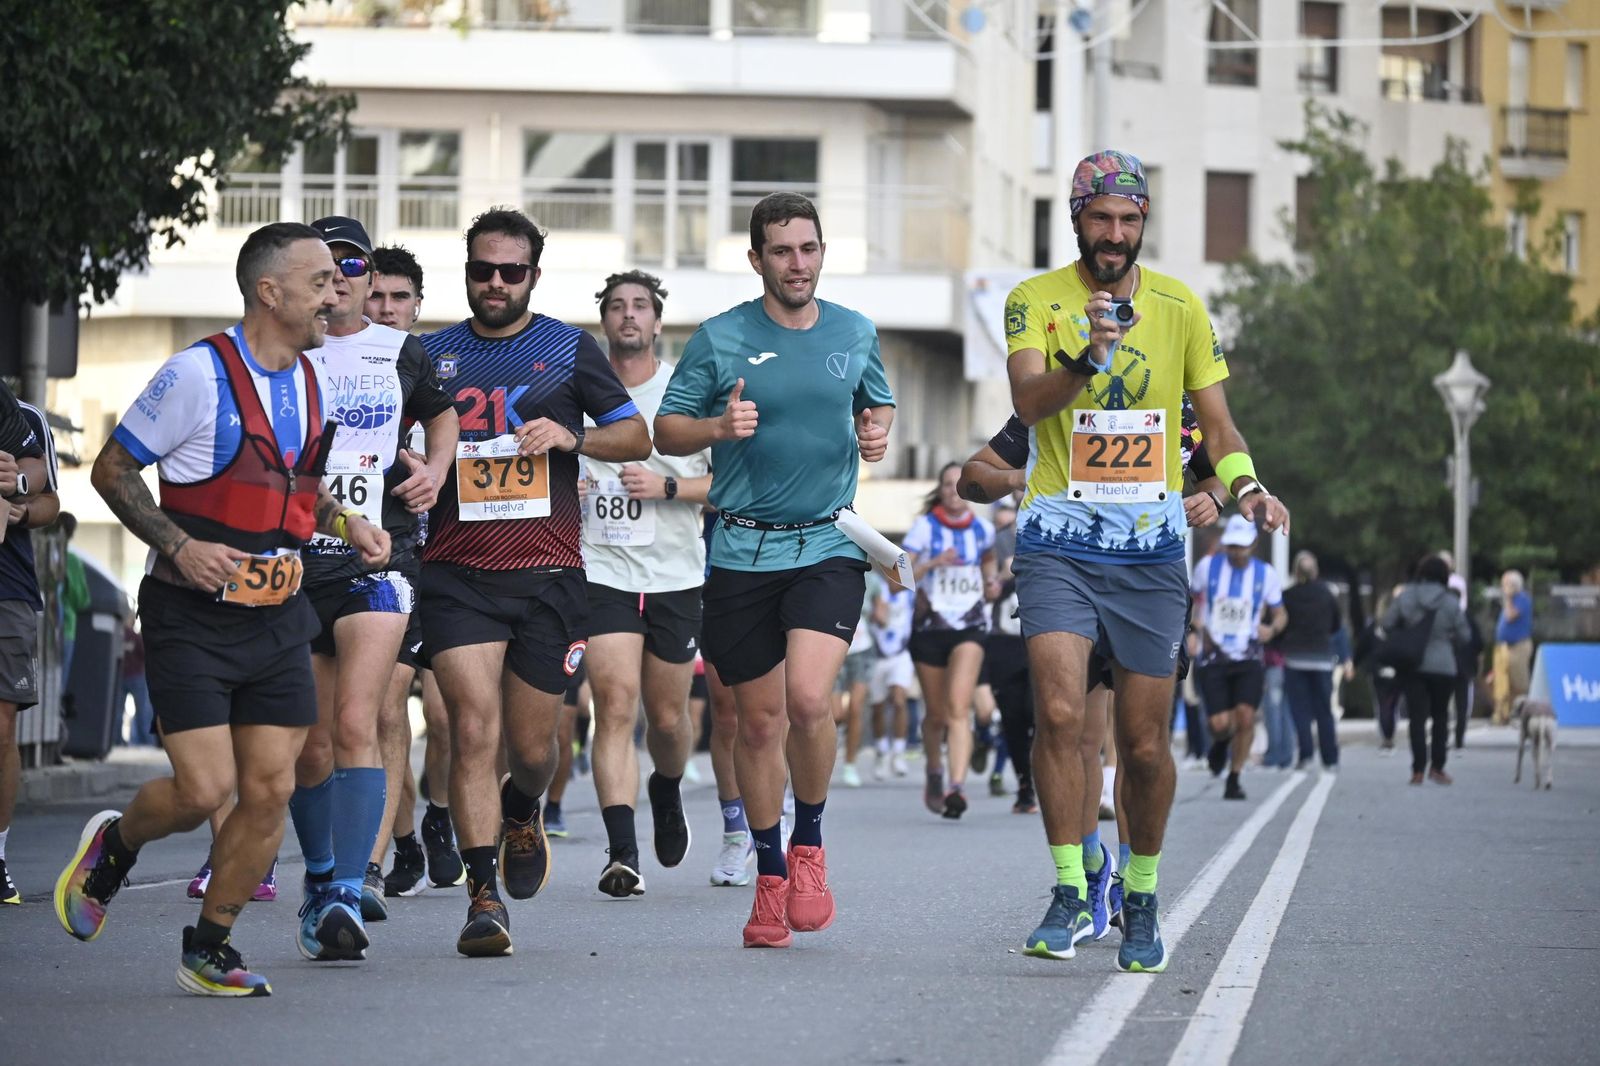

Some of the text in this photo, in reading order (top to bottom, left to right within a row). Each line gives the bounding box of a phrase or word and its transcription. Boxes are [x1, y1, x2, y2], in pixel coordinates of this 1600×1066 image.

[1138, 368, 1151, 401] RUNNING
[455, 385, 530, 435] 21K
[1086, 435, 1152, 468] 222
[472, 456, 535, 489] 379
[1096, 484, 1139, 495] Huelva
[484, 502, 524, 513] Huelva
[595, 495, 642, 520] 680
[940, 579, 979, 594] 1104
